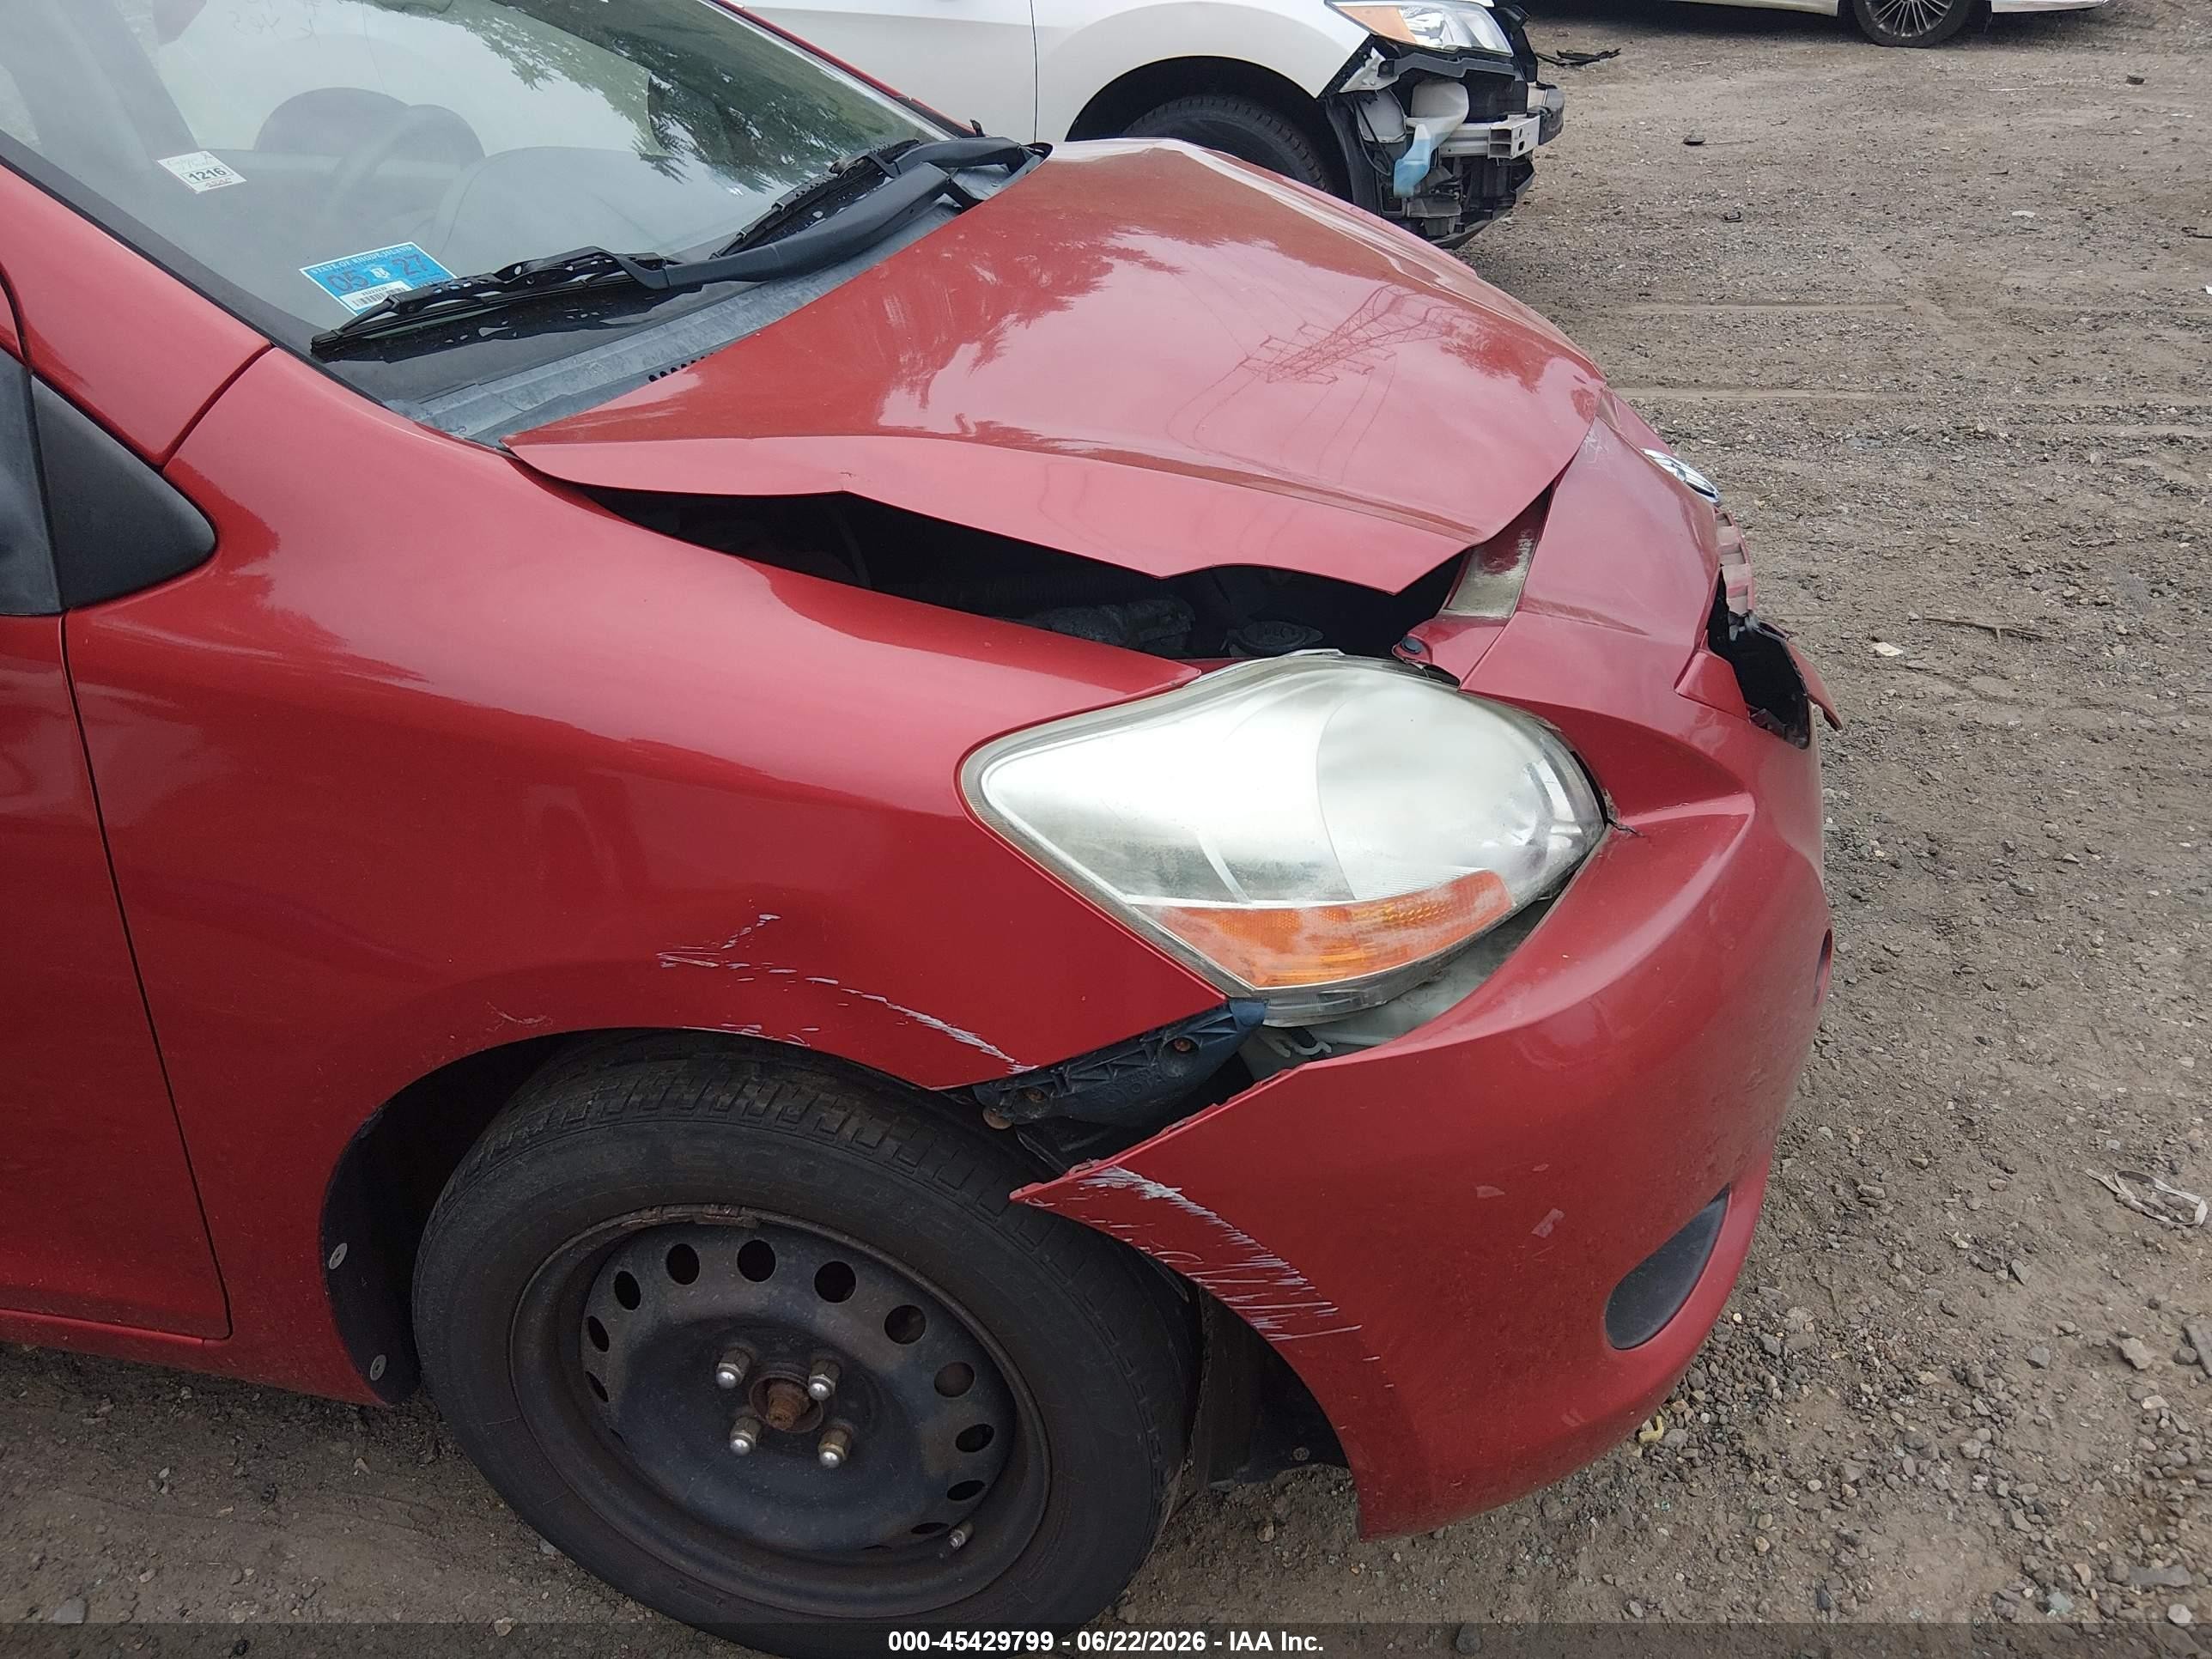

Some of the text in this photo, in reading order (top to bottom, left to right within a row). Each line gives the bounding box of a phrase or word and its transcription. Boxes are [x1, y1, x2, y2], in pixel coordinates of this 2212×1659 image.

[188, 167, 227, 181] 1216
[310, 263, 339, 273] STATE
[352, 252, 383, 264] RHODE
[381, 245, 412, 257] ISLAND
[326, 270, 370, 291] 05
[392, 254, 428, 276] 27
